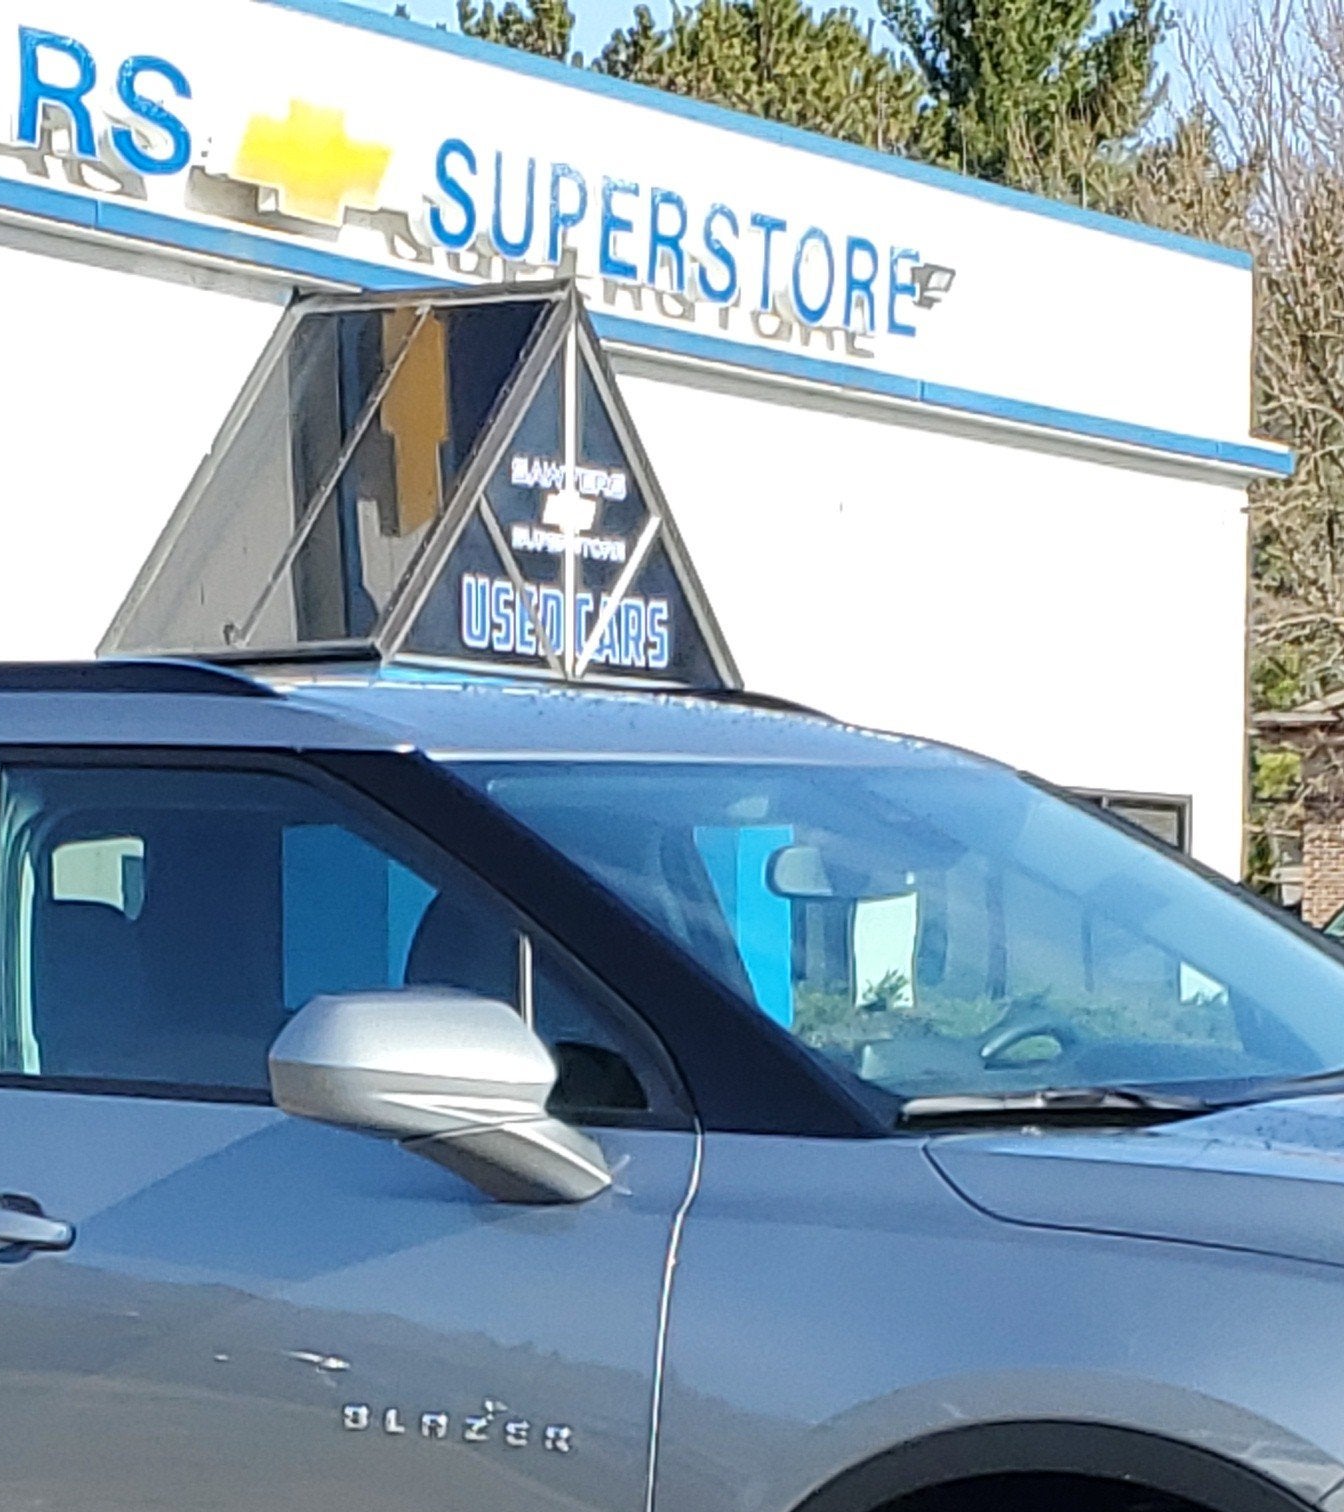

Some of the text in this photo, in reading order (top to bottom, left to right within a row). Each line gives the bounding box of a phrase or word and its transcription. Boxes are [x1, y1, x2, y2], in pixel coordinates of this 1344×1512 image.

[429, 138, 921, 337] SUPERSTORE
[461, 573, 669, 669] USED CARS
[342, 1402, 573, 1452] BLAZER
